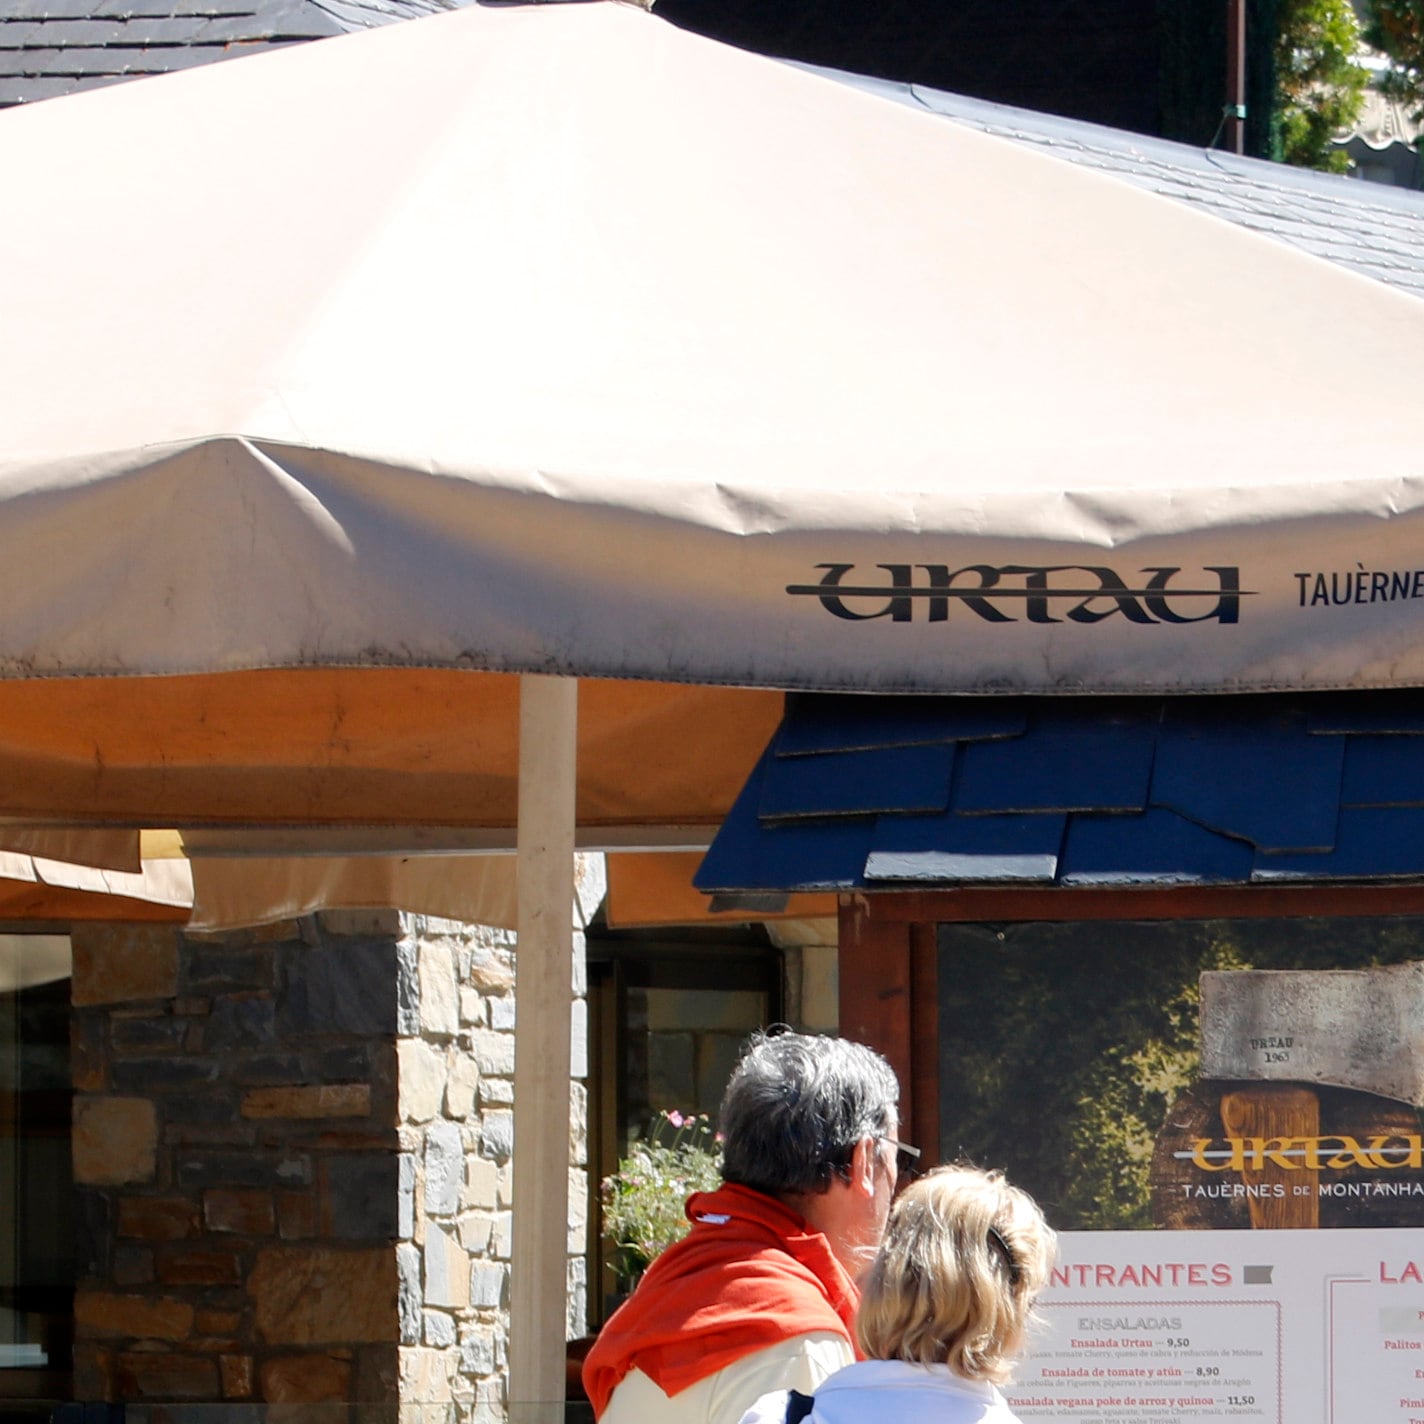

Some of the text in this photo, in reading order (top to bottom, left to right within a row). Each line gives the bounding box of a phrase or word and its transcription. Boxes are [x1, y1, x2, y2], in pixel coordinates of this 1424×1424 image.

[815, 562, 1239, 625] URTAU
[1251, 1038, 1293, 1050] URTAU
[1265, 1051, 1289, 1062] 1963
[1191, 1135, 1421, 1171] URTAU
[1183, 1180, 1424, 1198] TAUÈRNES DE MONTANHA
[1048, 1263, 1233, 1288] NTRANTES
[1078, 1317, 1183, 1331] ENSALADAS
[1071, 1338, 1190, 1349] Ensalada Urtau 9,50
[1384, 1340, 1421, 1349] Palitos
[1041, 1367, 1219, 1380] Ensalada de tomate y atún 8,90
[1056, 1399, 1094, 1409] vegana
[1097, 1397, 1121, 1408] poke
[1124, 1397, 1136, 1406] de
[1168, 1399, 1176, 1408] y
[1178, 1397, 1214, 1408] quinoa
[1227, 1396, 1255, 1407] 11,50
